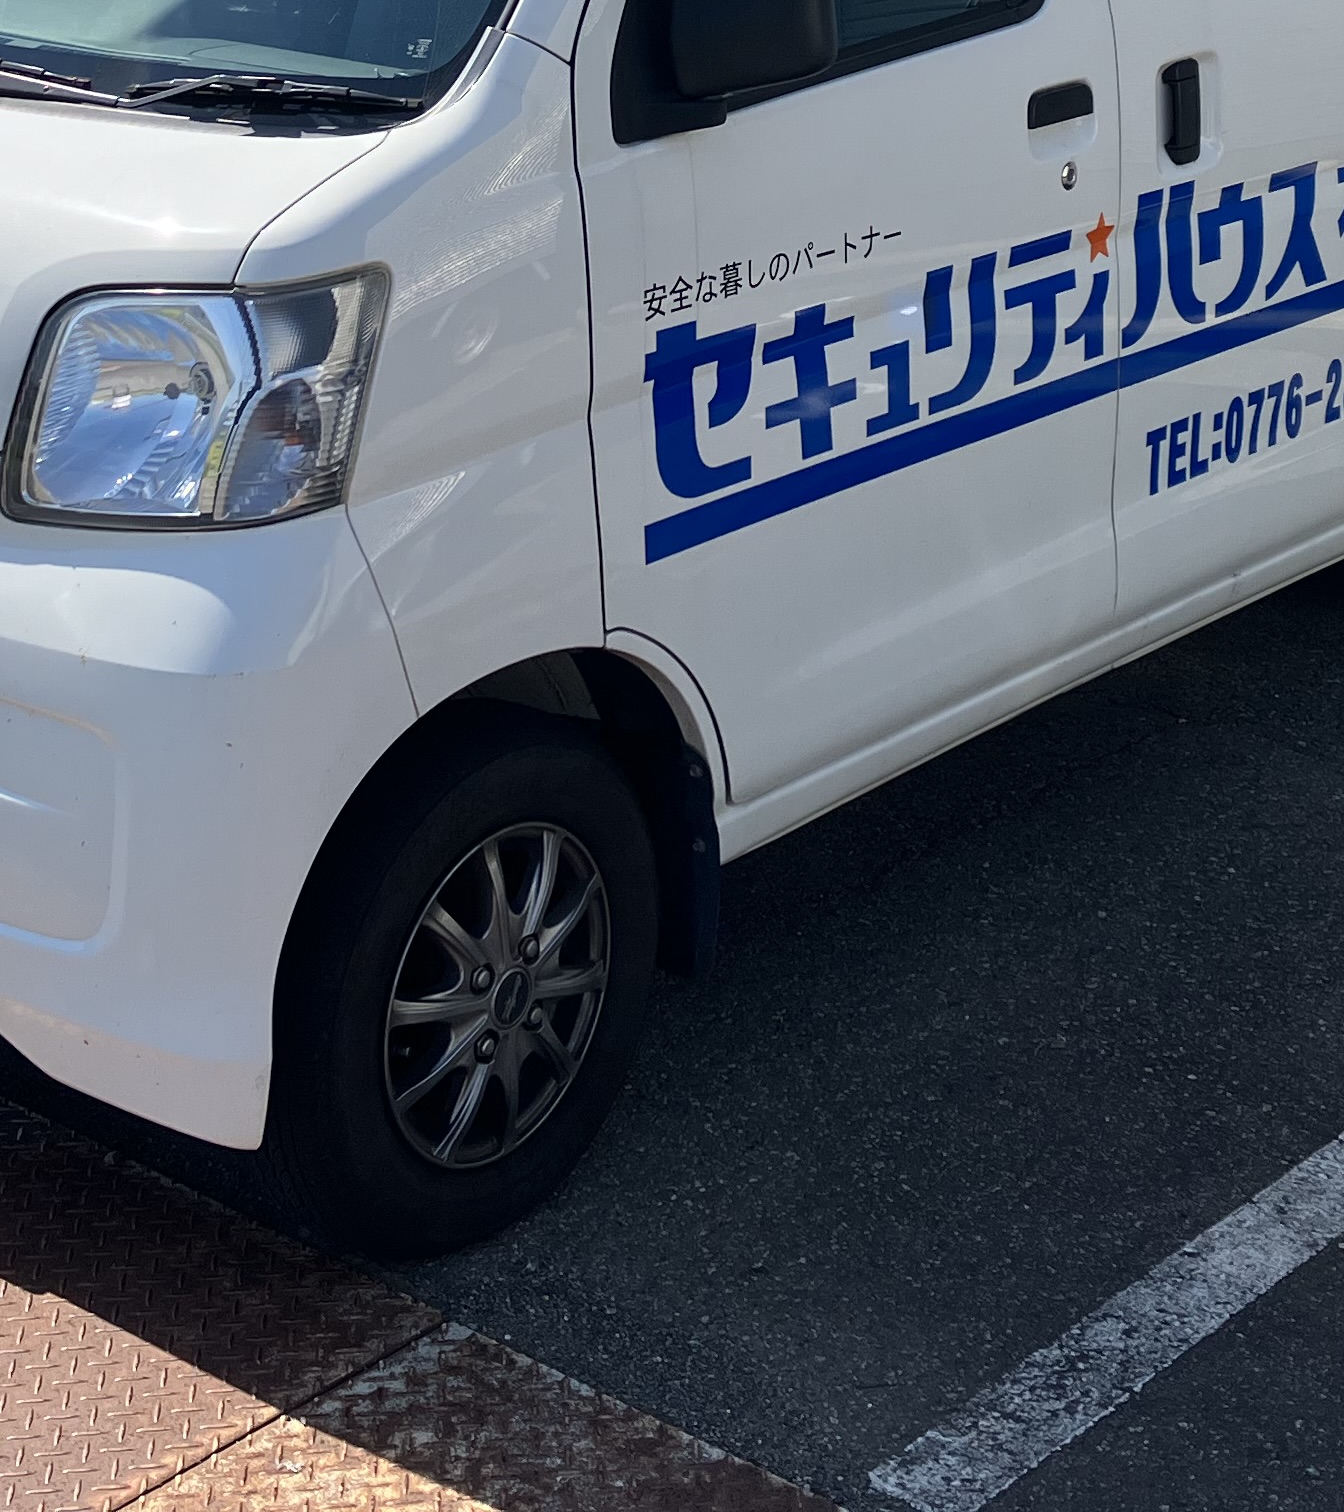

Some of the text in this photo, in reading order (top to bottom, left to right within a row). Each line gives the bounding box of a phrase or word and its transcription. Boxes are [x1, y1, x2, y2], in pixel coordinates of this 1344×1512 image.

[642, 225, 902, 322] 安全な暮しのパートナー
